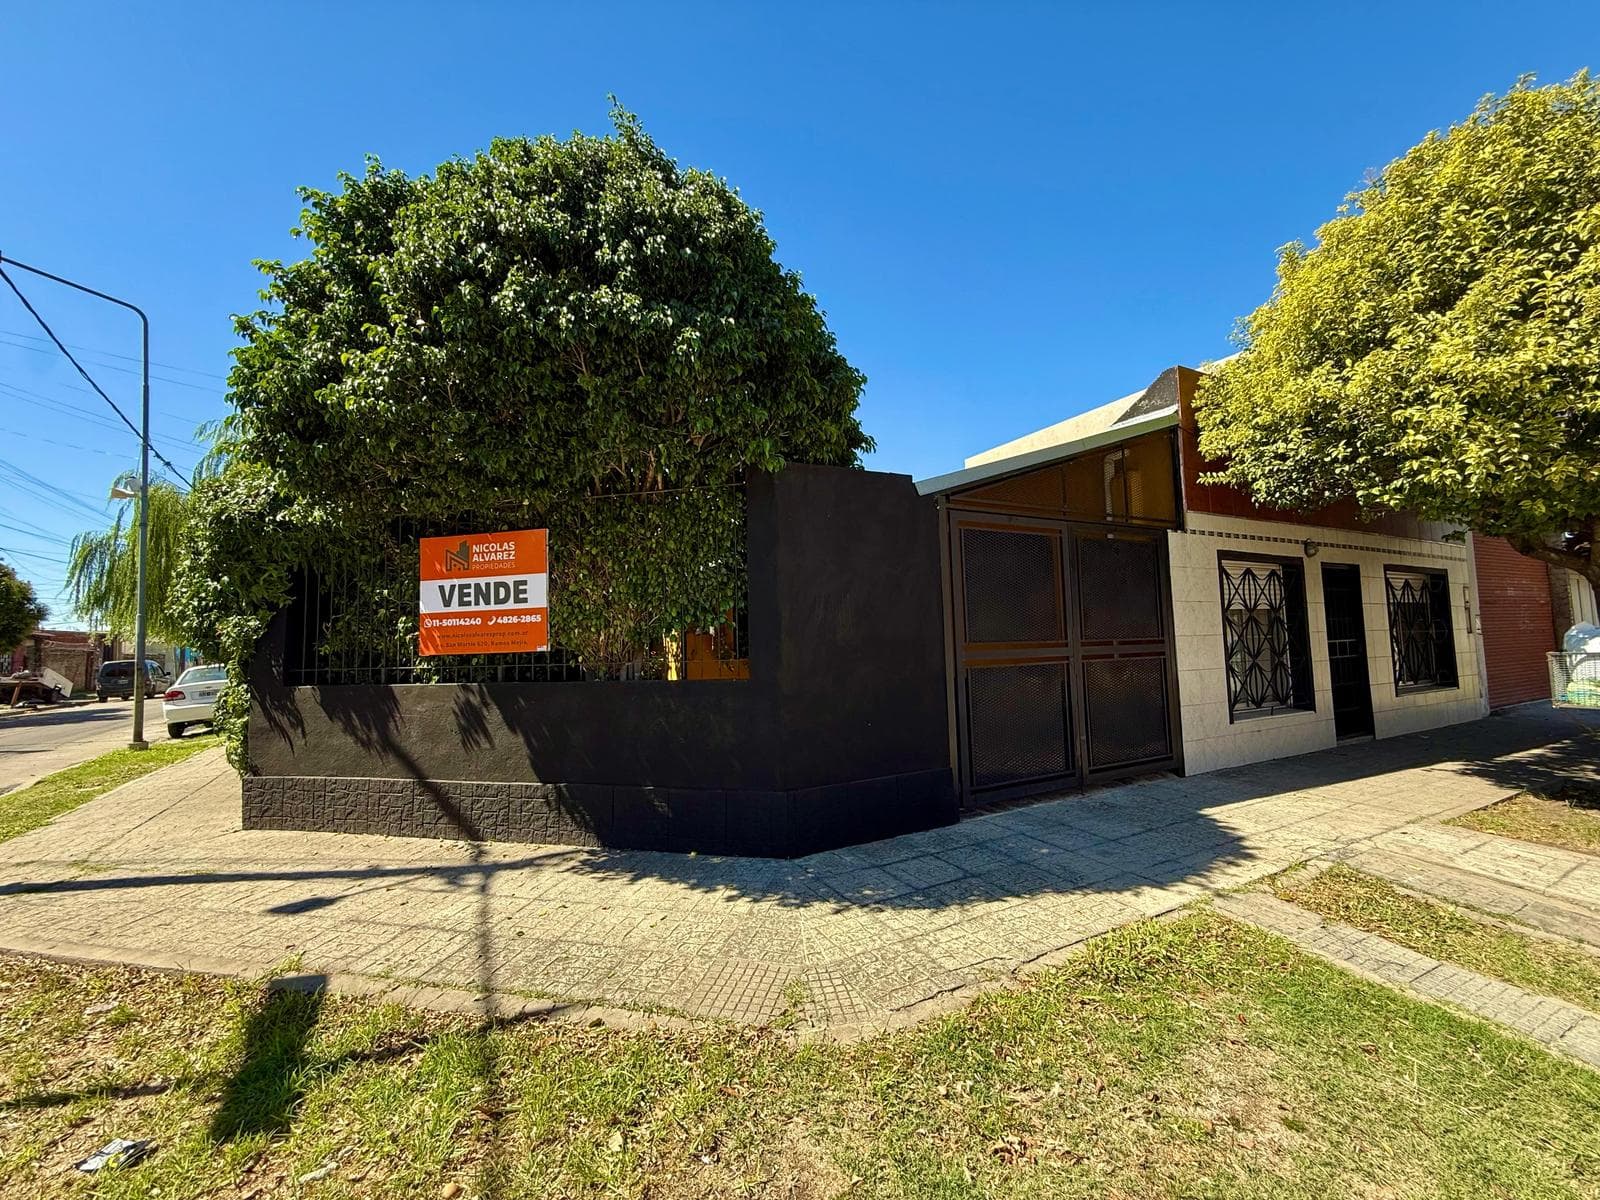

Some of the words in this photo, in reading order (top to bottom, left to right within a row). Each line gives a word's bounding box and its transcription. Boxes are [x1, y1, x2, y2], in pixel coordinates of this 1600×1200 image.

[472, 541, 516, 553] NICOLAS
[472, 551, 516, 562] ALVAREZ
[472, 562, 516, 570] PROPIEDADES
[438, 580, 528, 608] VENDE
[432, 617, 482, 627] 11-50114240
[497, 614, 541, 624] 4826-2865
